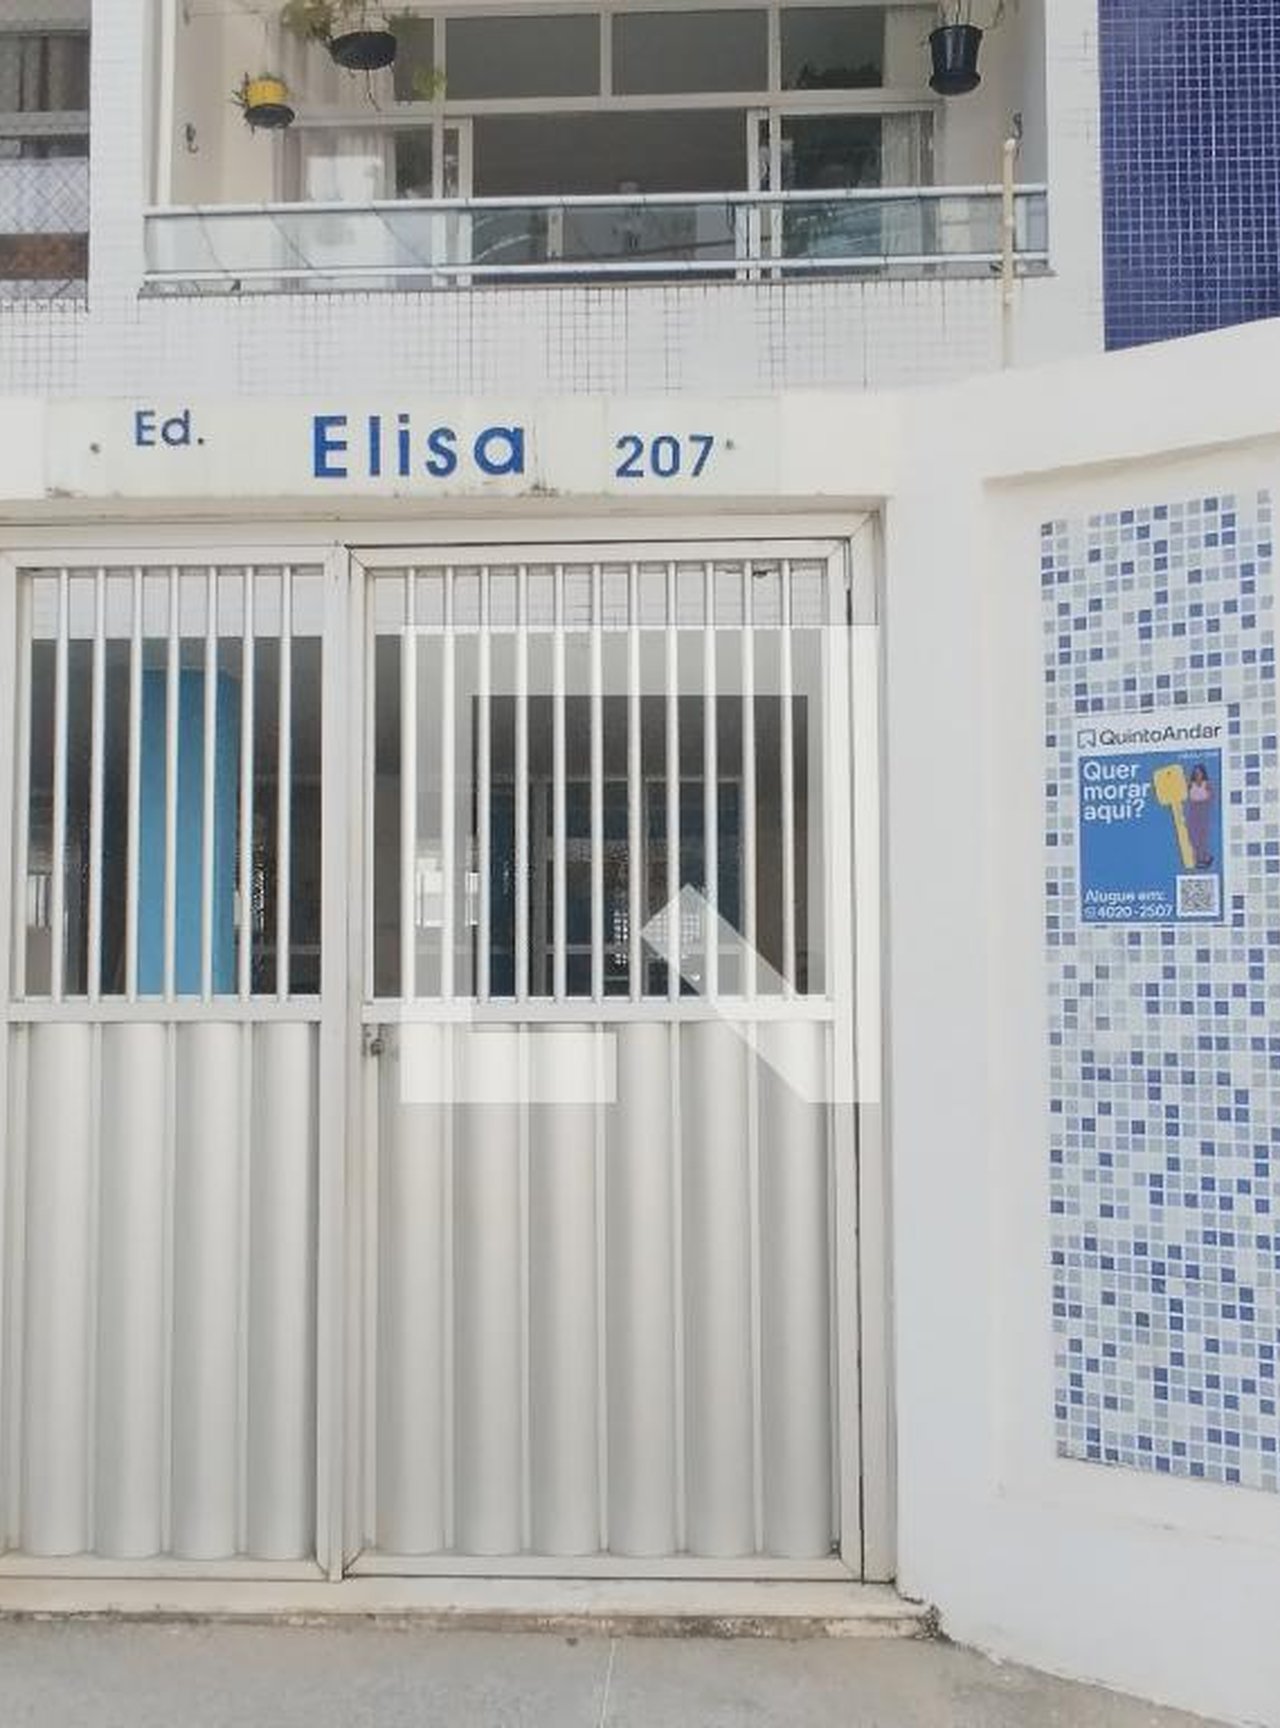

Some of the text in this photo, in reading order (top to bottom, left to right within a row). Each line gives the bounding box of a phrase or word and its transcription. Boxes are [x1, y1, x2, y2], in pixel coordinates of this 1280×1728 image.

[134, 410, 716, 478] Ed. Elisa 207
[1100, 725, 1221, 746] QuintoAndar
[1083, 761, 1140, 780] Quer
[1084, 782, 1151, 799] morar
[1084, 801, 1144, 824] aqui?
